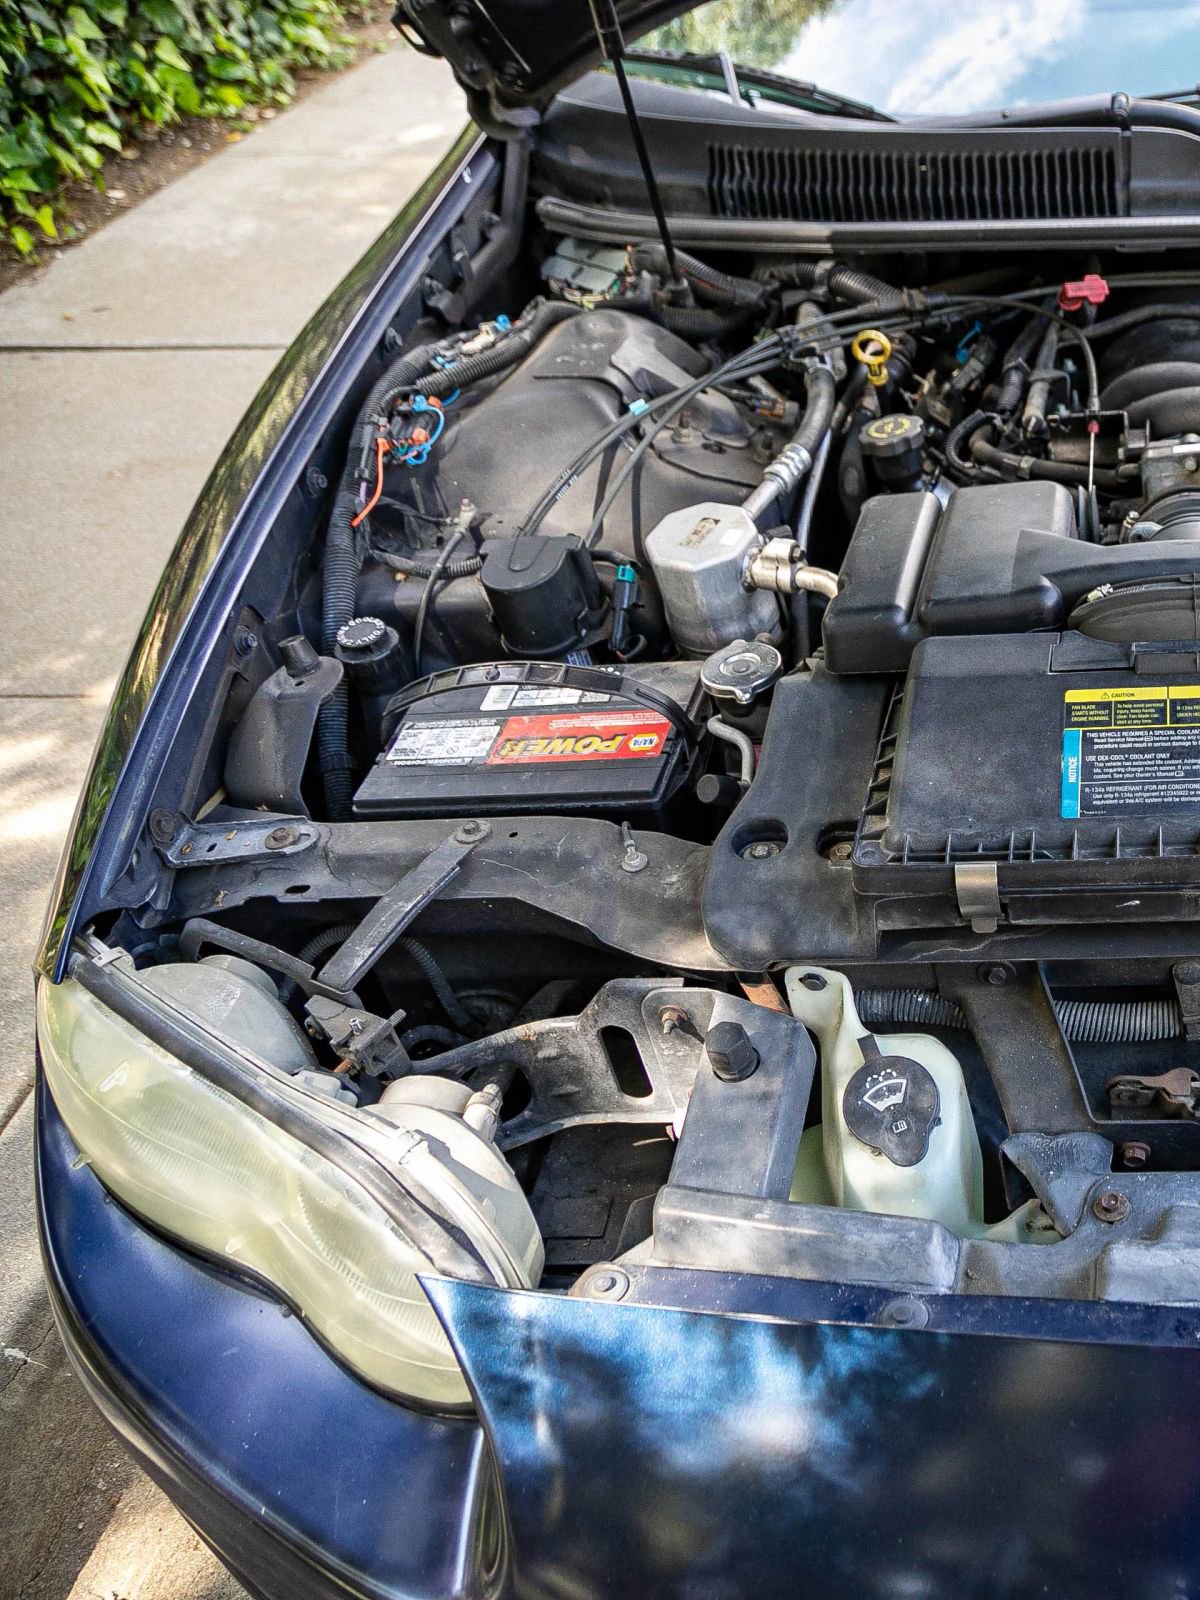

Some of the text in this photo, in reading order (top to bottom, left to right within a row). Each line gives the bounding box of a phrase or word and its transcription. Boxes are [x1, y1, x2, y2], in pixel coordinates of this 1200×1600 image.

[498, 734, 627, 757] POWER
[633, 737, 656, 746] NAPA
[1068, 756, 1078, 783] NOTICE
